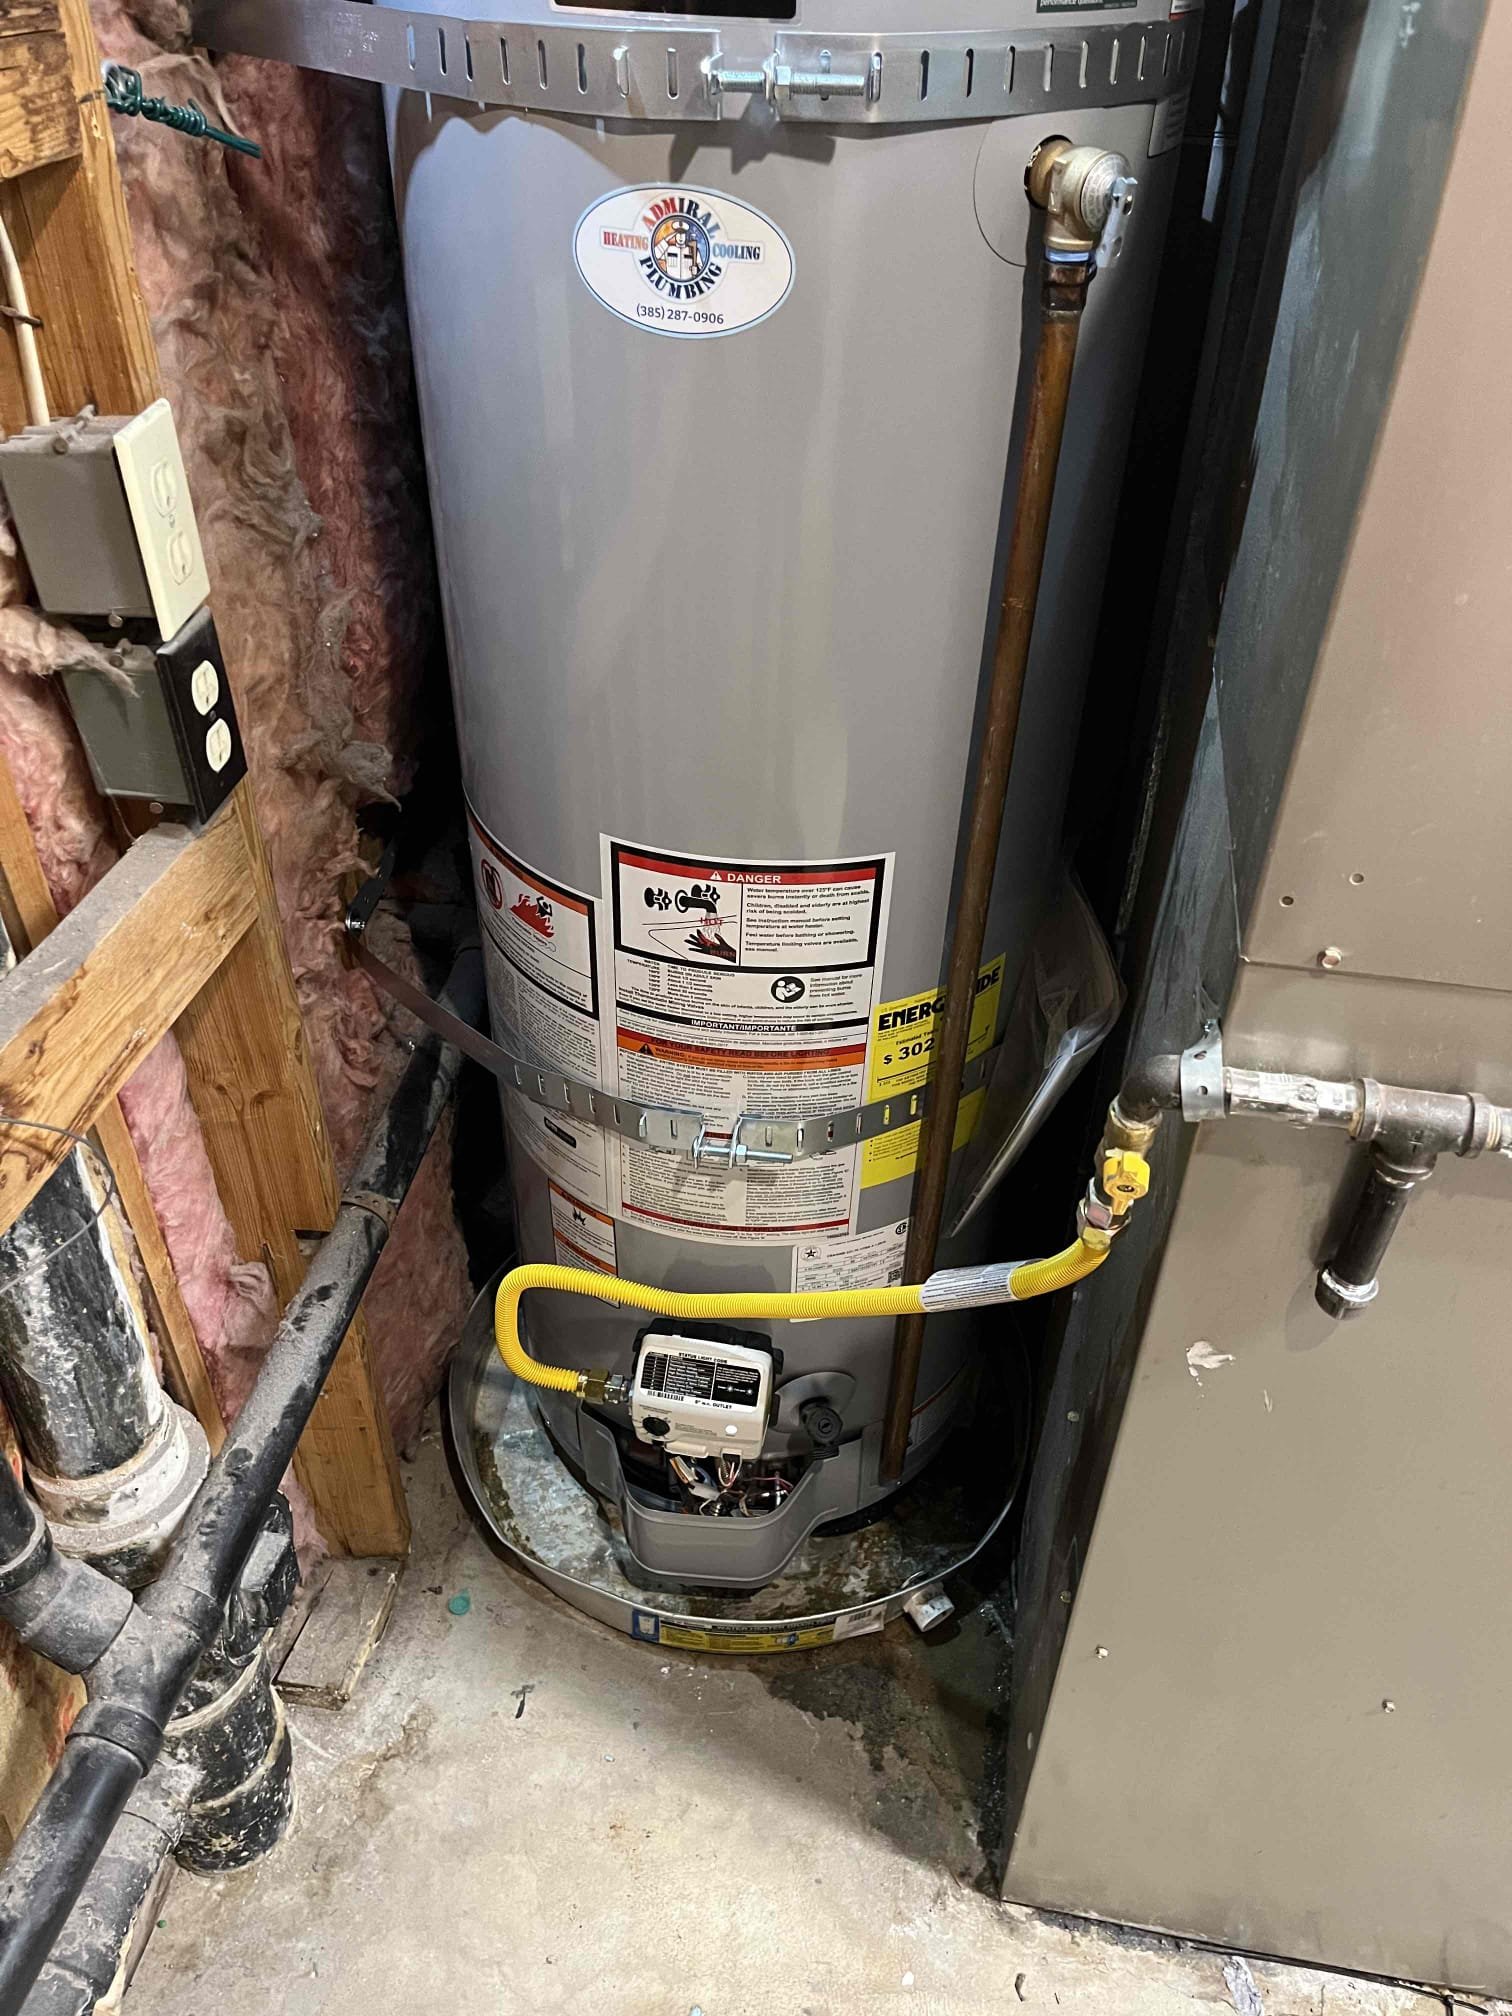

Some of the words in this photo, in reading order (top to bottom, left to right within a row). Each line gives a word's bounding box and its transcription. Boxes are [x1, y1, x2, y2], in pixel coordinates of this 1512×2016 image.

[642, 197, 721, 239] ADMIRAL
[603, 231, 649, 250] HEATING
[712, 241, 761, 261] COOLING
[639, 256, 723, 300] PLUMBING
[636, 302, 665, 319] (385)
[667, 304, 725, 324] 287-0906
[727, 873, 782, 884] DANGER
[849, 898, 869, 906] highest
[745, 939, 781, 947] Temperature
[690, 1018, 798, 1032] IMPORTANT/IMPORTANTE
[882, 1053, 893, 1066] $
[898, 1036, 937, 1061] 302
